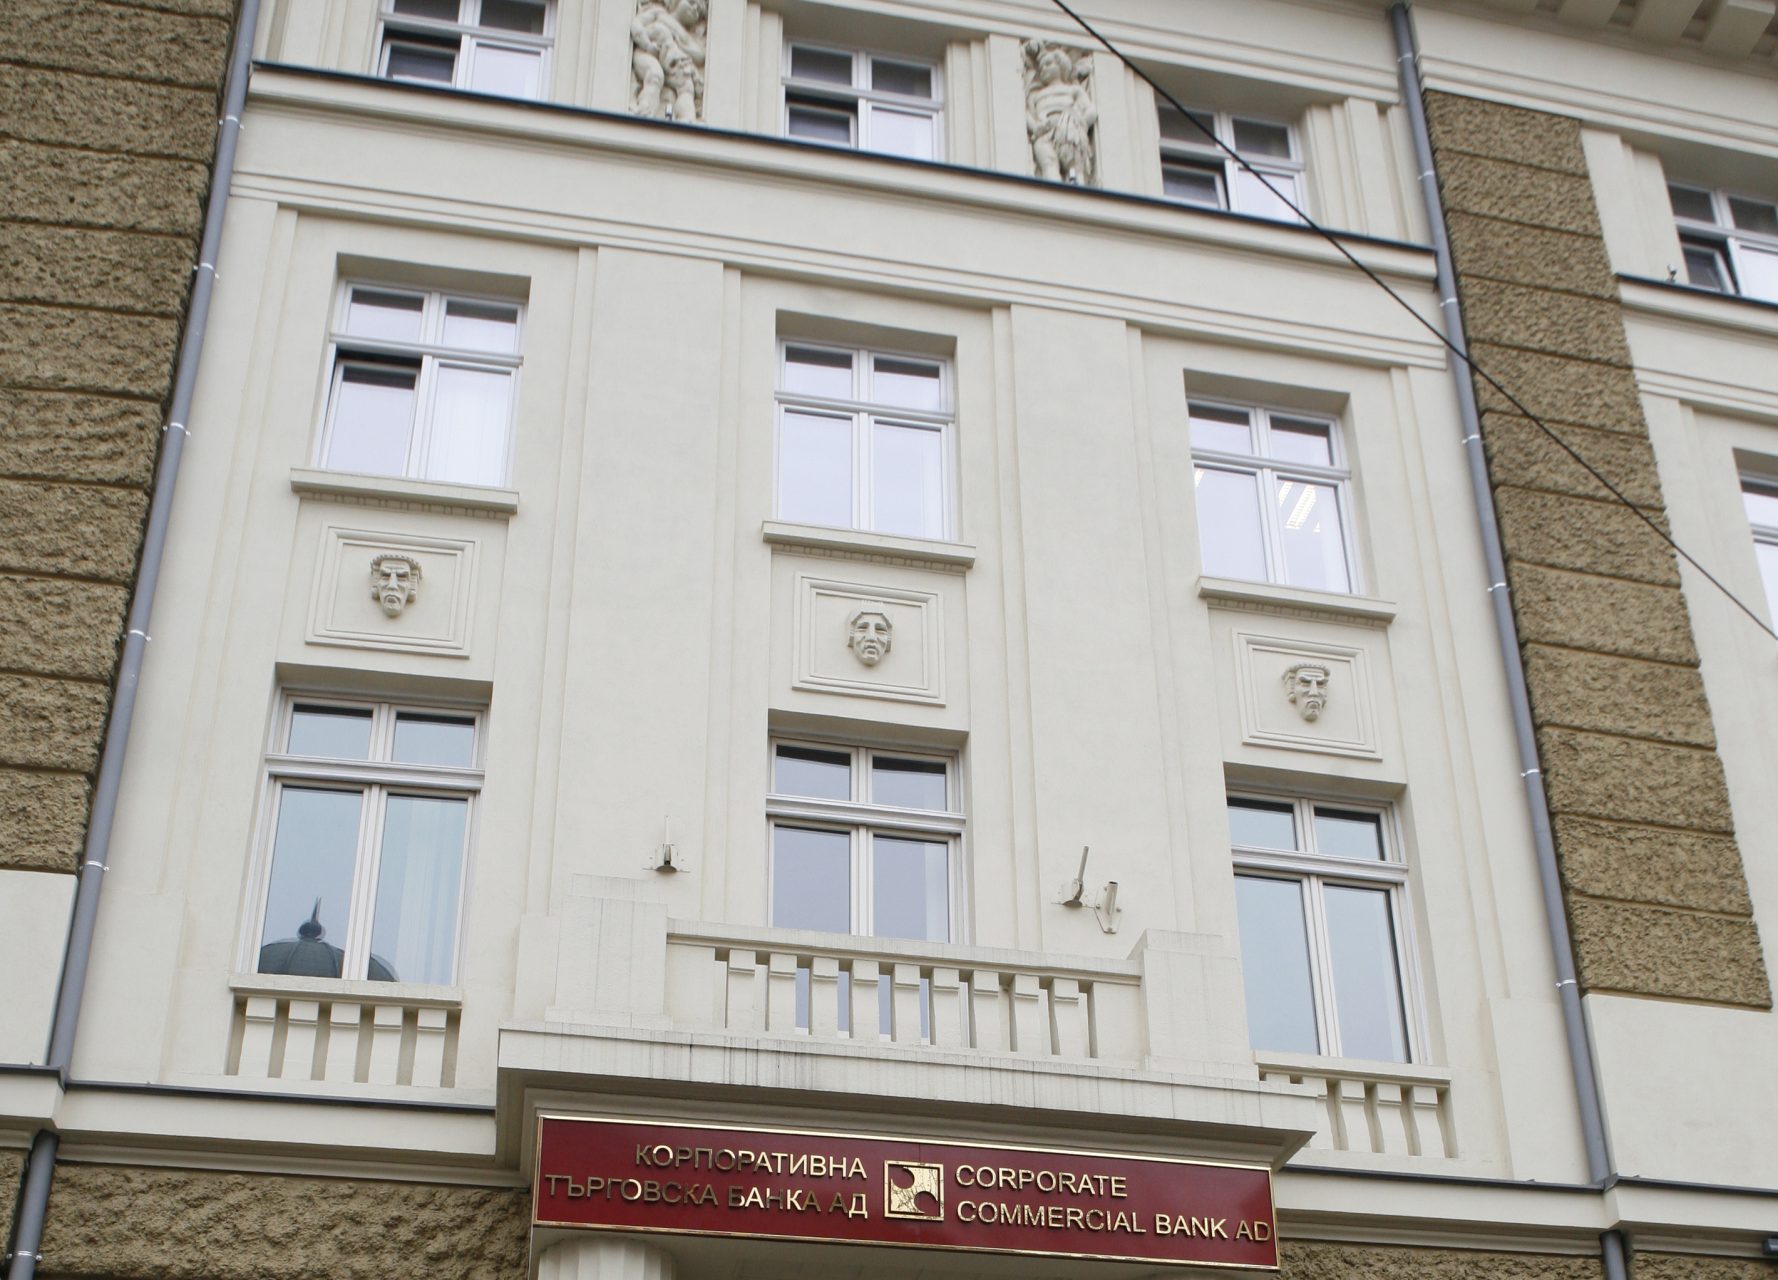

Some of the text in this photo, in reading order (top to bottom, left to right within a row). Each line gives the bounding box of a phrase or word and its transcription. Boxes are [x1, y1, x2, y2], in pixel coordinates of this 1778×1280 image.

[635, 1144, 867, 1179] КОРПОРАТИВНА
[545, 1174, 868, 1219] ТЪРГОВСКА БАНКА АД
[955, 1165, 1128, 1198] CORPORATE
[956, 1201, 1271, 1243] COMMERCIAL BANK AD
